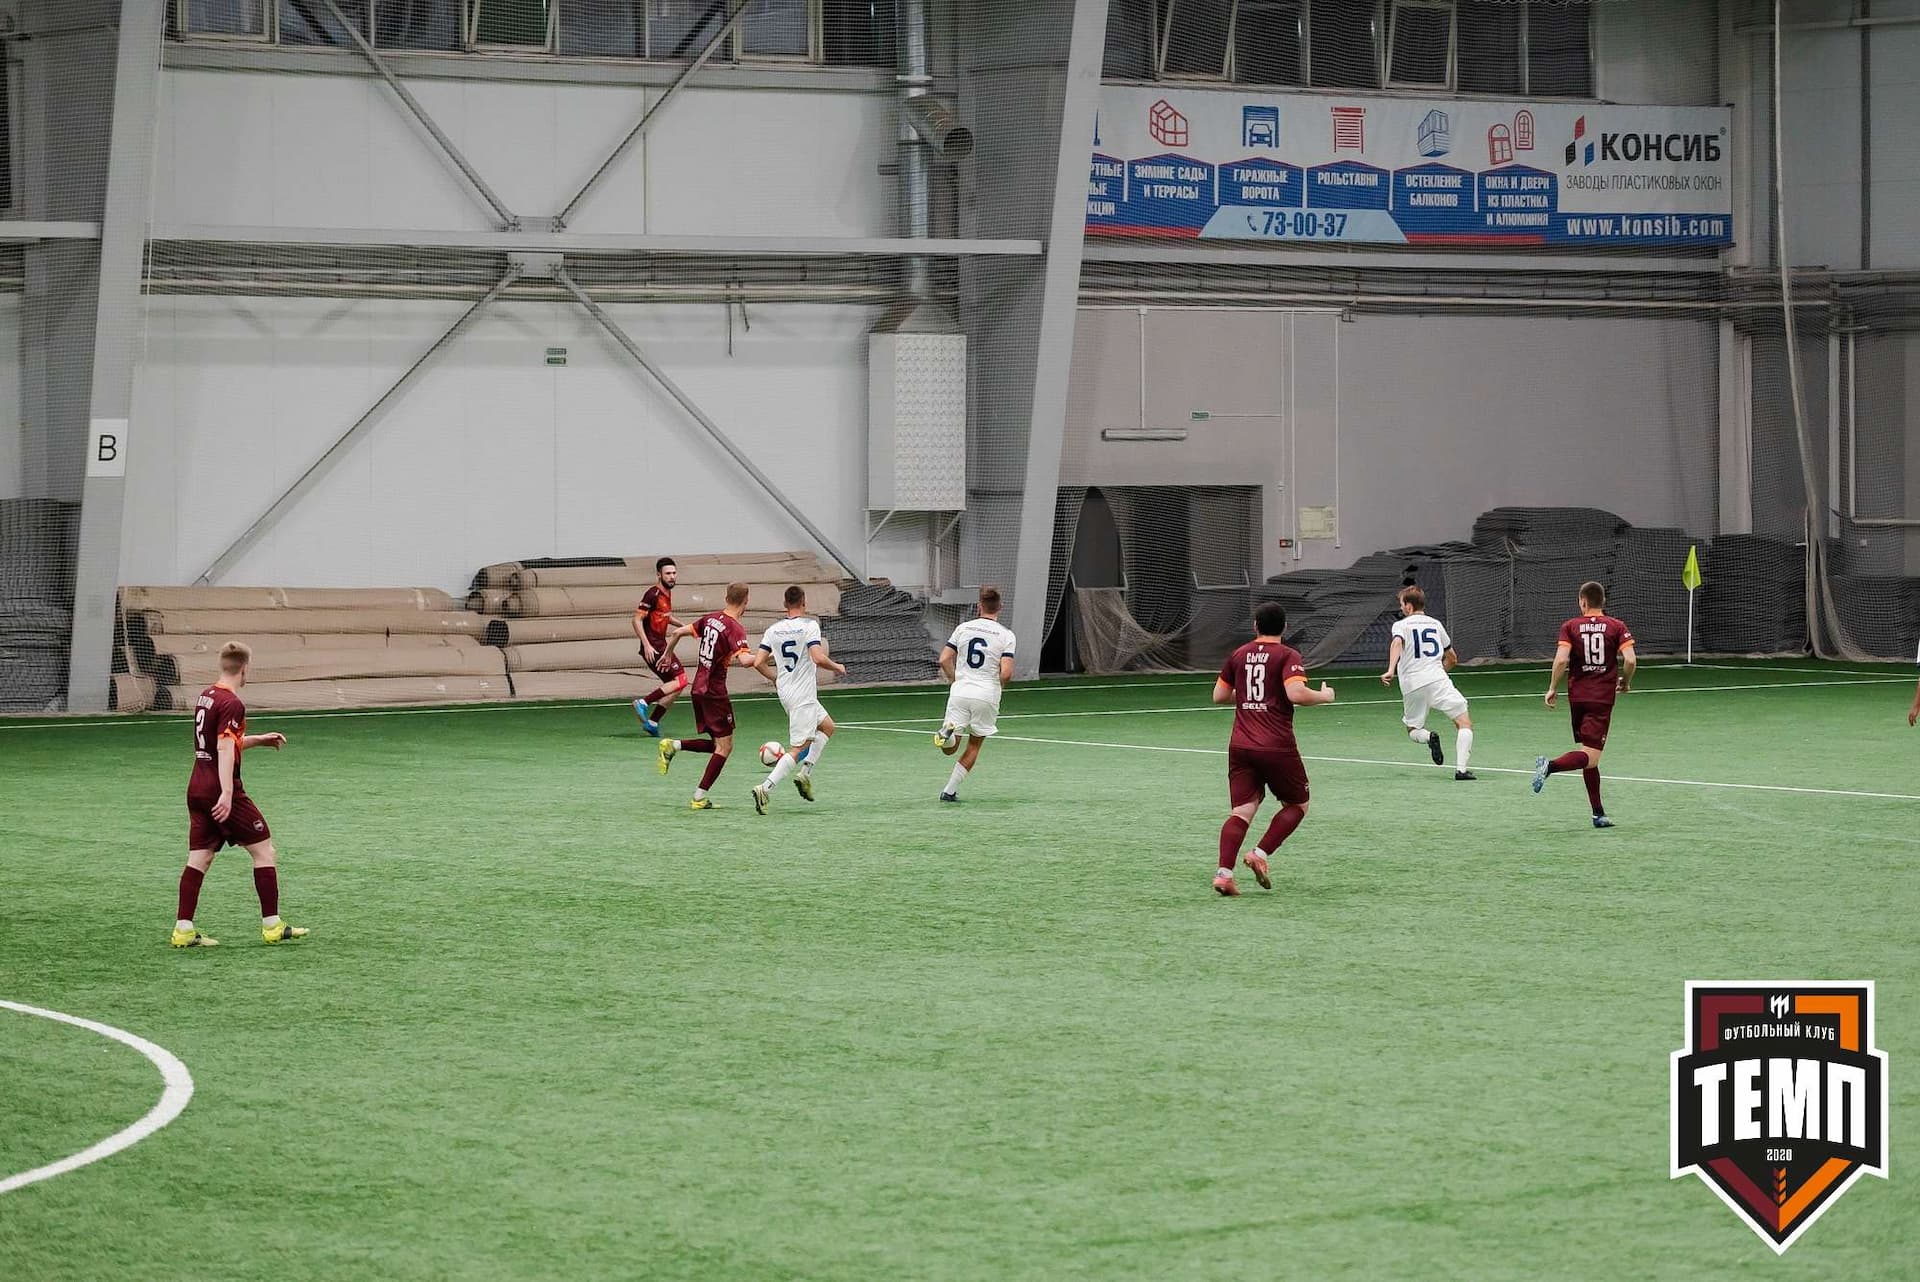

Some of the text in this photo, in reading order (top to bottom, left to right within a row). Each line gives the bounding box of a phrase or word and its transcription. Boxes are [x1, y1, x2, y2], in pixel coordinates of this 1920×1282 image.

[1601, 133, 1721, 162] КОНСИБ
[1134, 165, 1208, 182] ЗИМНИЕ САДЫ
[1233, 169, 1289, 184] ГАРАЖНЫЕ
[1317, 172, 1379, 187] РОЛЬСТАВНИ
[1405, 174, 1463, 188] ОСТЕКЛЕНИЕ
[1144, 184, 1199, 199] И ТЕРРАСЫ
[1485, 176, 1550, 190] ОКНА И ДВЕРИ
[1566, 175, 1722, 192] ЗАВОДЫ ПЛАСТИКОВЫХ ОКОН
[1242, 186, 1280, 200] ВОРОТА
[1410, 193, 1458, 207] БАЛКОНОВ
[1487, 195, 1549, 208] ИЗ ПЛАСТИКА
[1262, 211, 1348, 237] 73-00-37
[1486, 213, 1549, 226] И АЛЮМИНИЯ
[1566, 216, 1724, 236] www.konsib.com
[700, 625, 719, 660] 33
[1412, 628, 1440, 659] 15
[1581, 633, 1605, 665] 19
[781, 640, 799, 672] 5
[966, 637, 988, 669] 6
[1244, 663, 1266, 702] 13
[195, 709, 206, 749] 2
